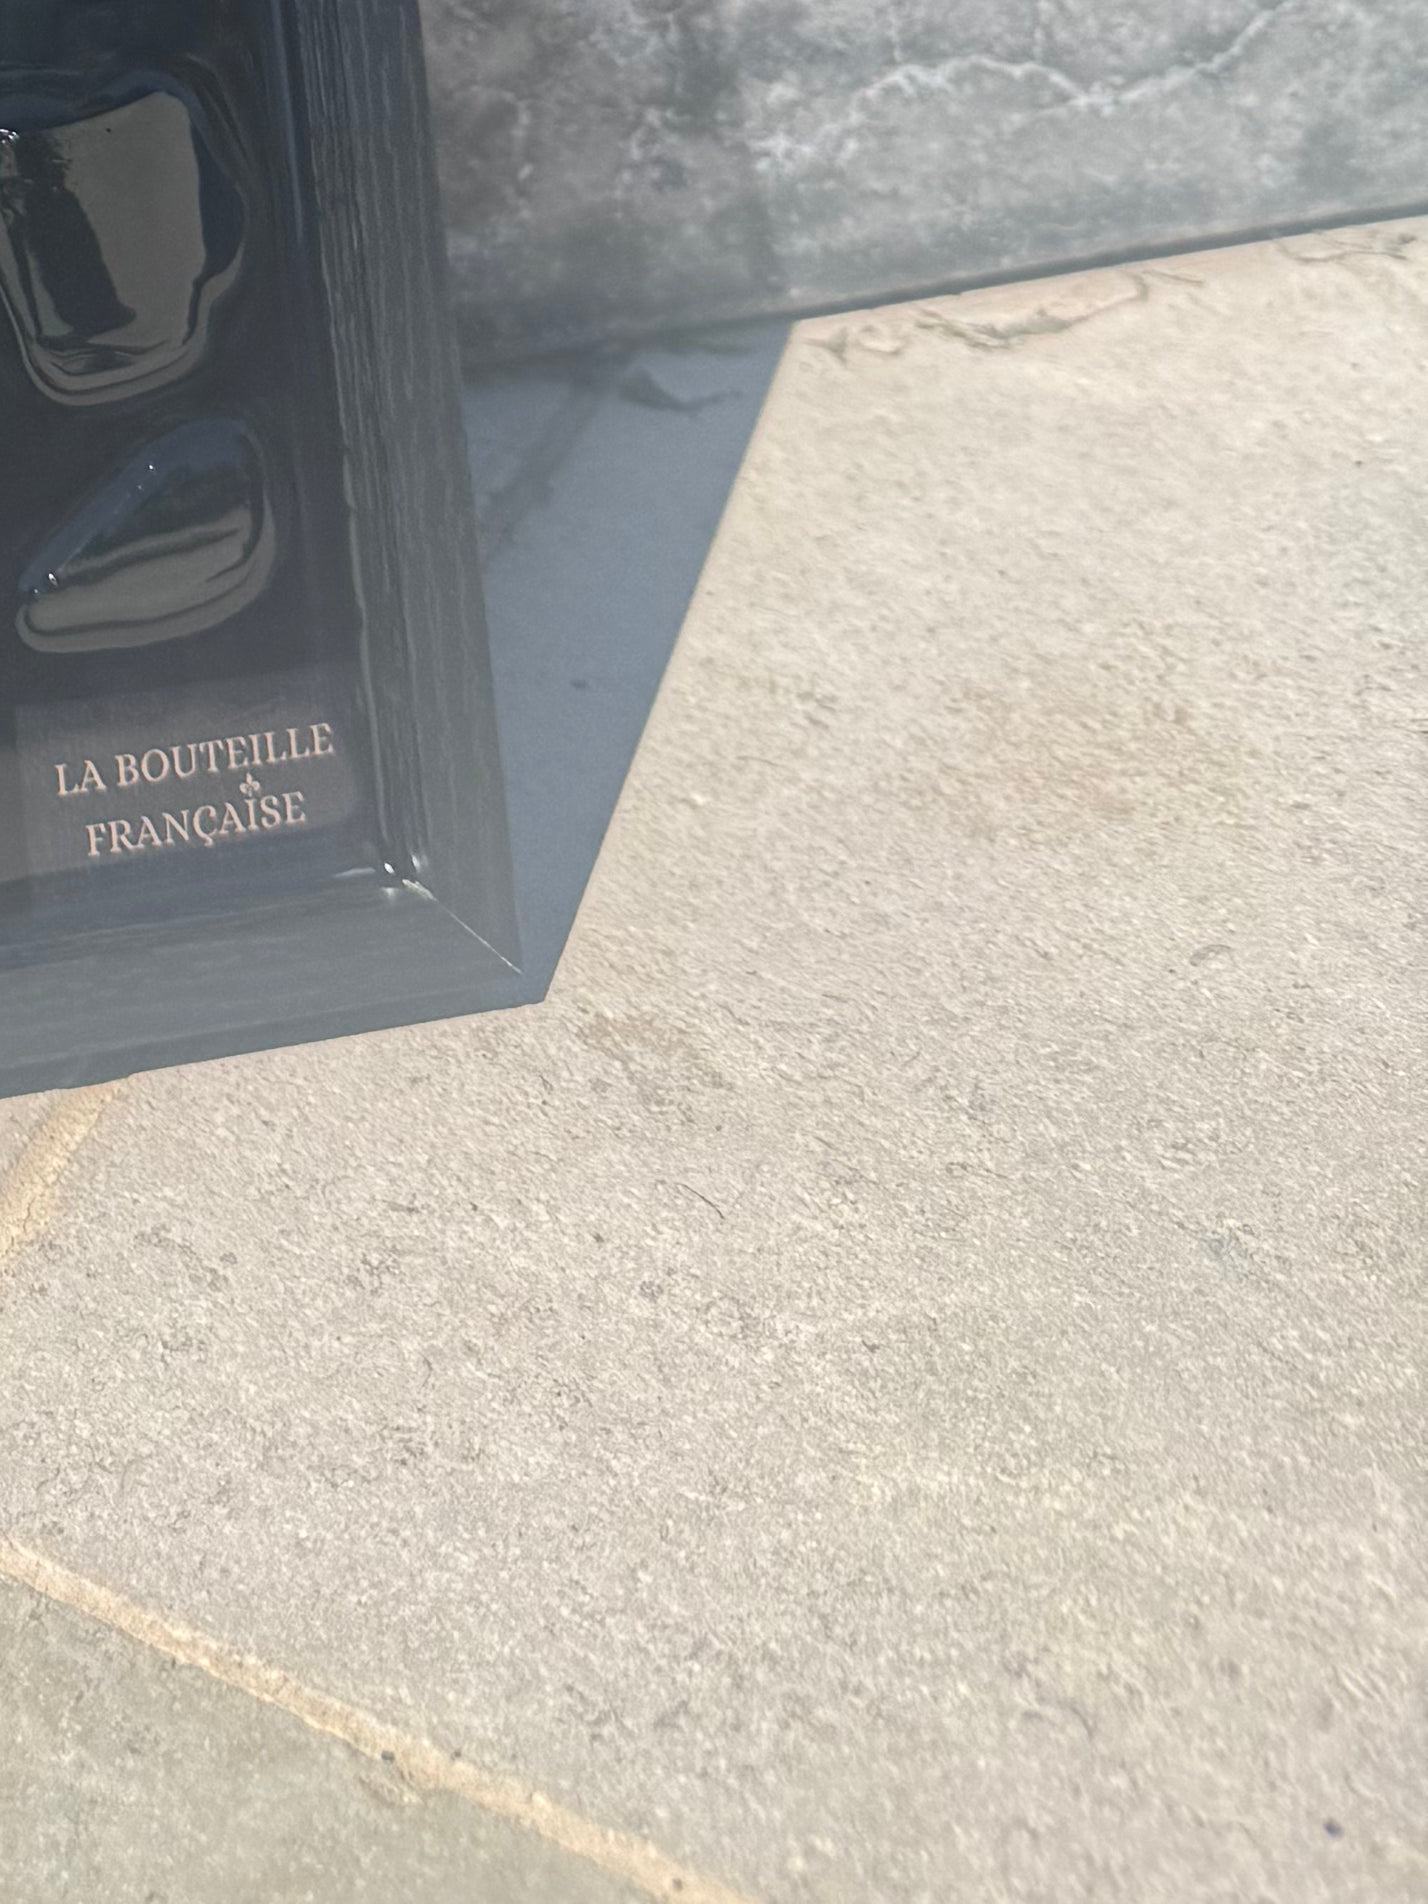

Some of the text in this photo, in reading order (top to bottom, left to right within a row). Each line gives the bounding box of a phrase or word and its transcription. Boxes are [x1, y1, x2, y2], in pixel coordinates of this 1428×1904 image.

[55, 722, 335, 796] LA BOUTEILLE
[85, 791, 307, 857] FRANÇAISE
